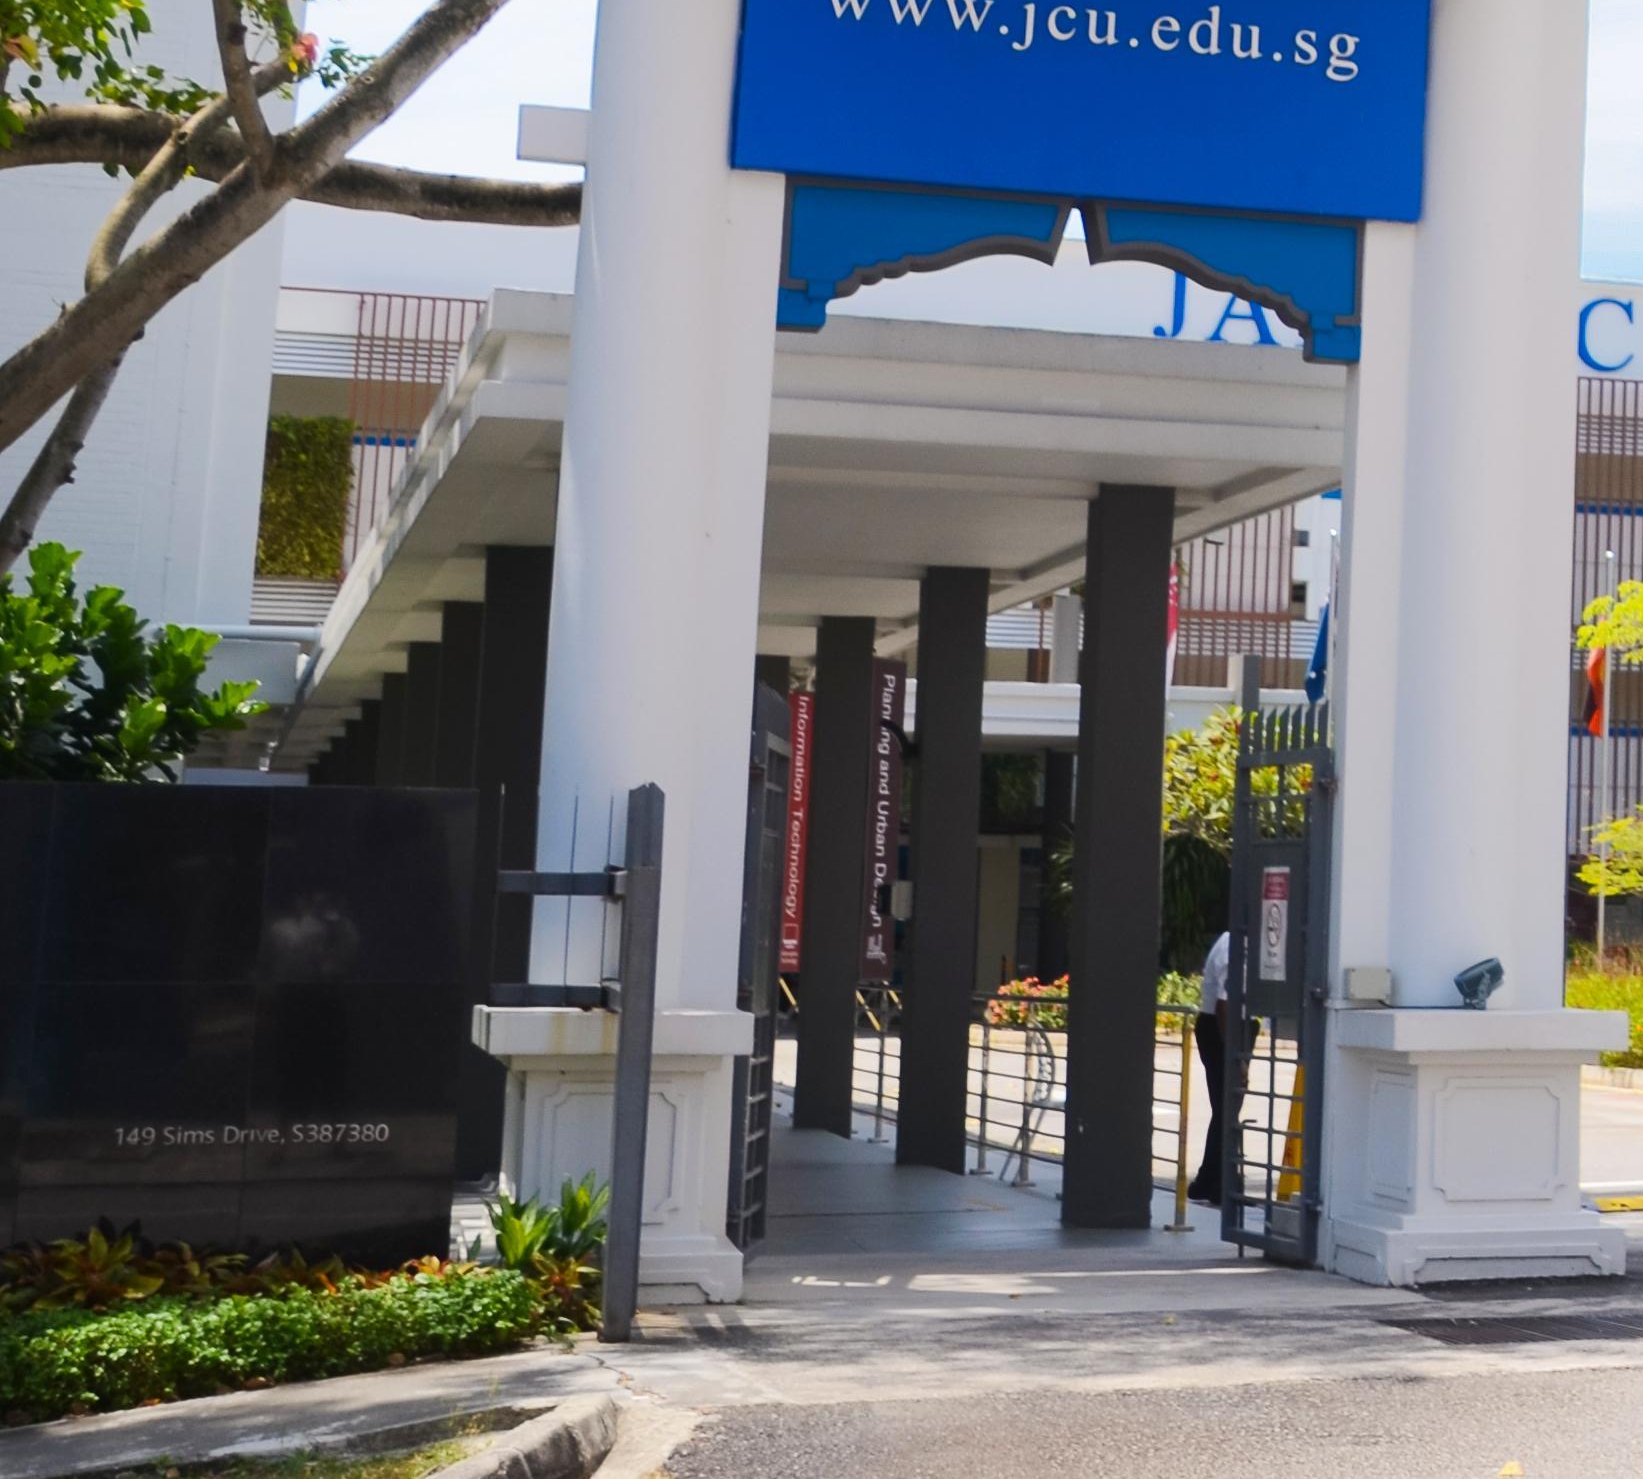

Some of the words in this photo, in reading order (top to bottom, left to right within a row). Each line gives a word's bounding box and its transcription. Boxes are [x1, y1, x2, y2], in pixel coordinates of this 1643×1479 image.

[793, 695, 810, 802] Information
[879, 760, 891, 795] and
[874, 801, 891, 857] Urban
[785, 807, 804, 919] Technology
[115, 1126, 157, 1146] 149
[163, 1125, 216, 1146] Sims
[223, 1125, 286, 1146] Drive,
[291, 1122, 390, 1144] S387380
